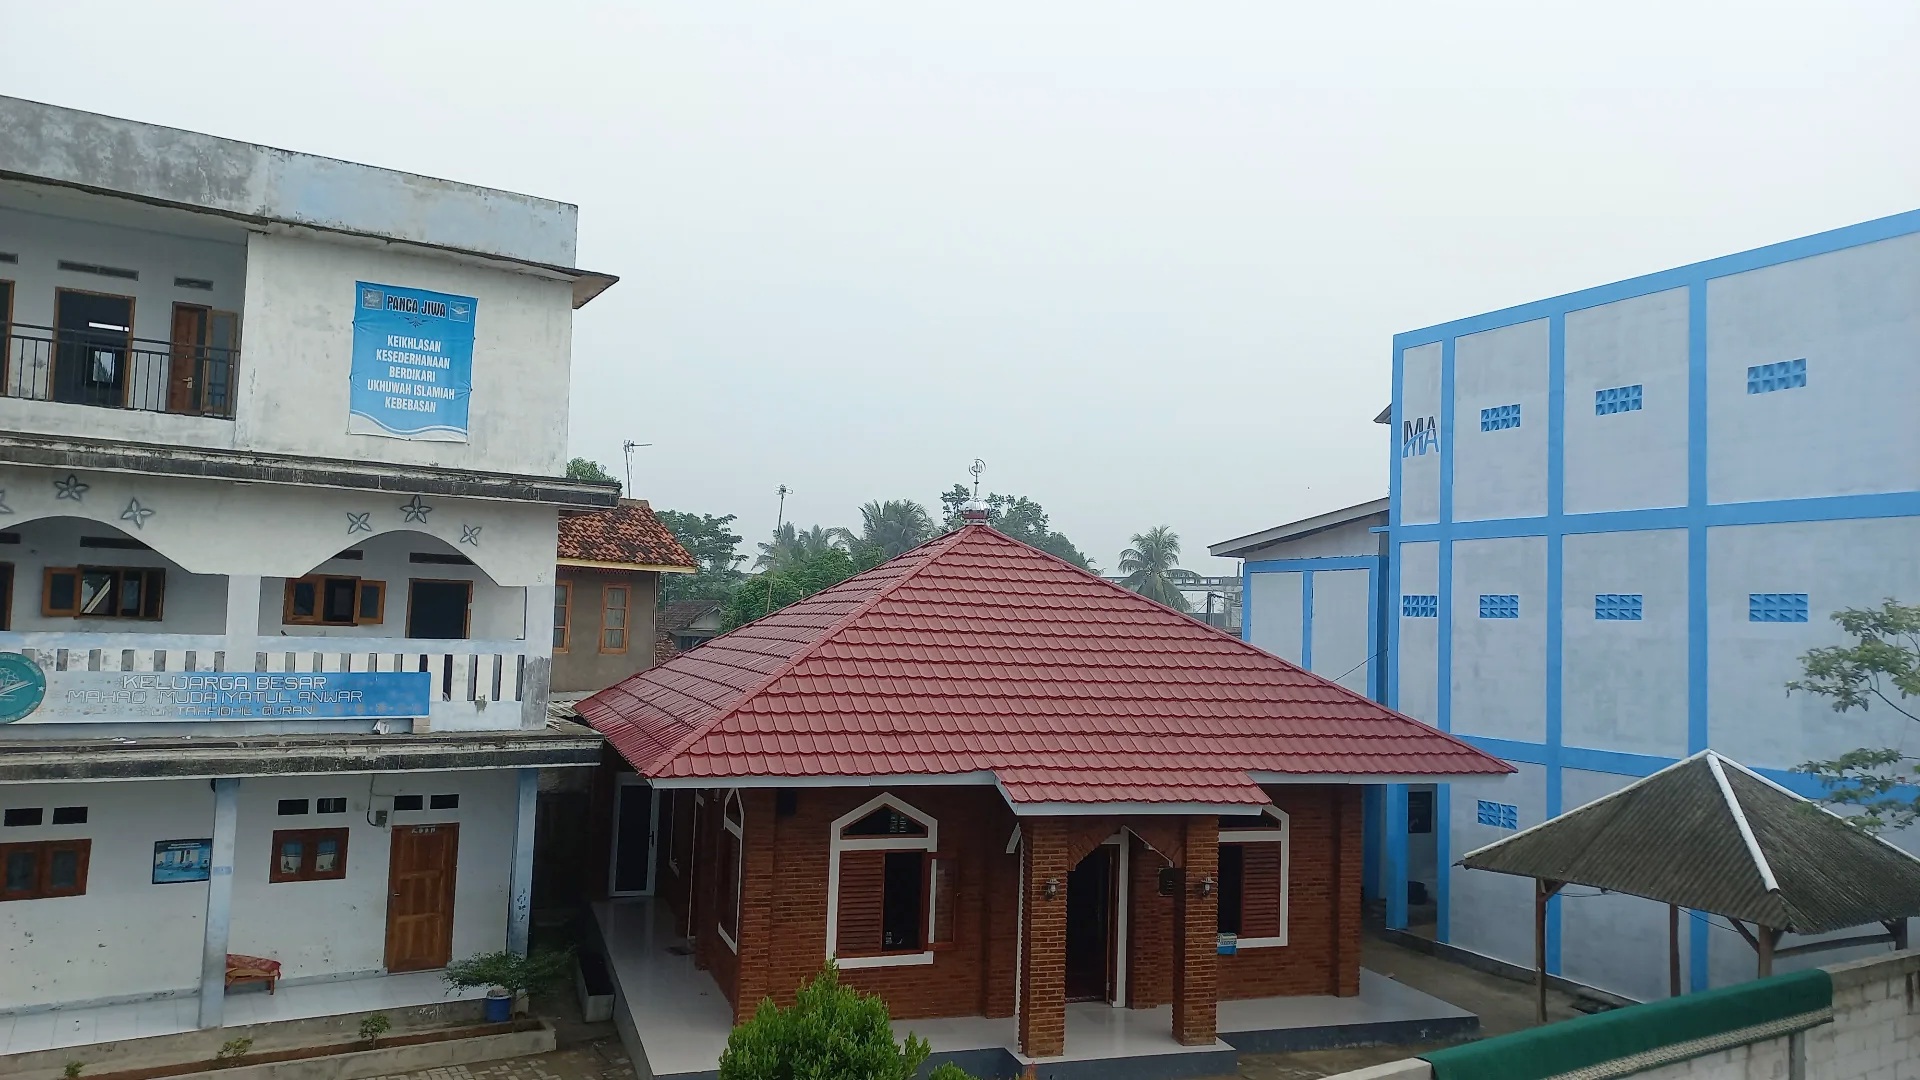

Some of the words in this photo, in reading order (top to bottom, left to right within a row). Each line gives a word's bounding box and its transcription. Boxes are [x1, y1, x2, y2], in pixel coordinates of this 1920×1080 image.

[386, 294, 419, 314] PANCA
[421, 300, 446, 318] JIWA
[387, 334, 441, 353] KEIKHLASAN
[376, 348, 451, 370] KESEDERHANAAN
[389, 365, 436, 382] BERDIKARI
[367, 379, 411, 396] UKHUWAH
[413, 384, 455, 400] ISLAMIAH
[384, 396, 436, 413] KEBEBASAN
[1403, 416, 1439, 458] MA
[122, 675, 249, 691] KELUARGA
[255, 676, 328, 691] BESAR
[298, 690, 364, 704] ANWAR
[261, 705, 314, 717] QURAN
